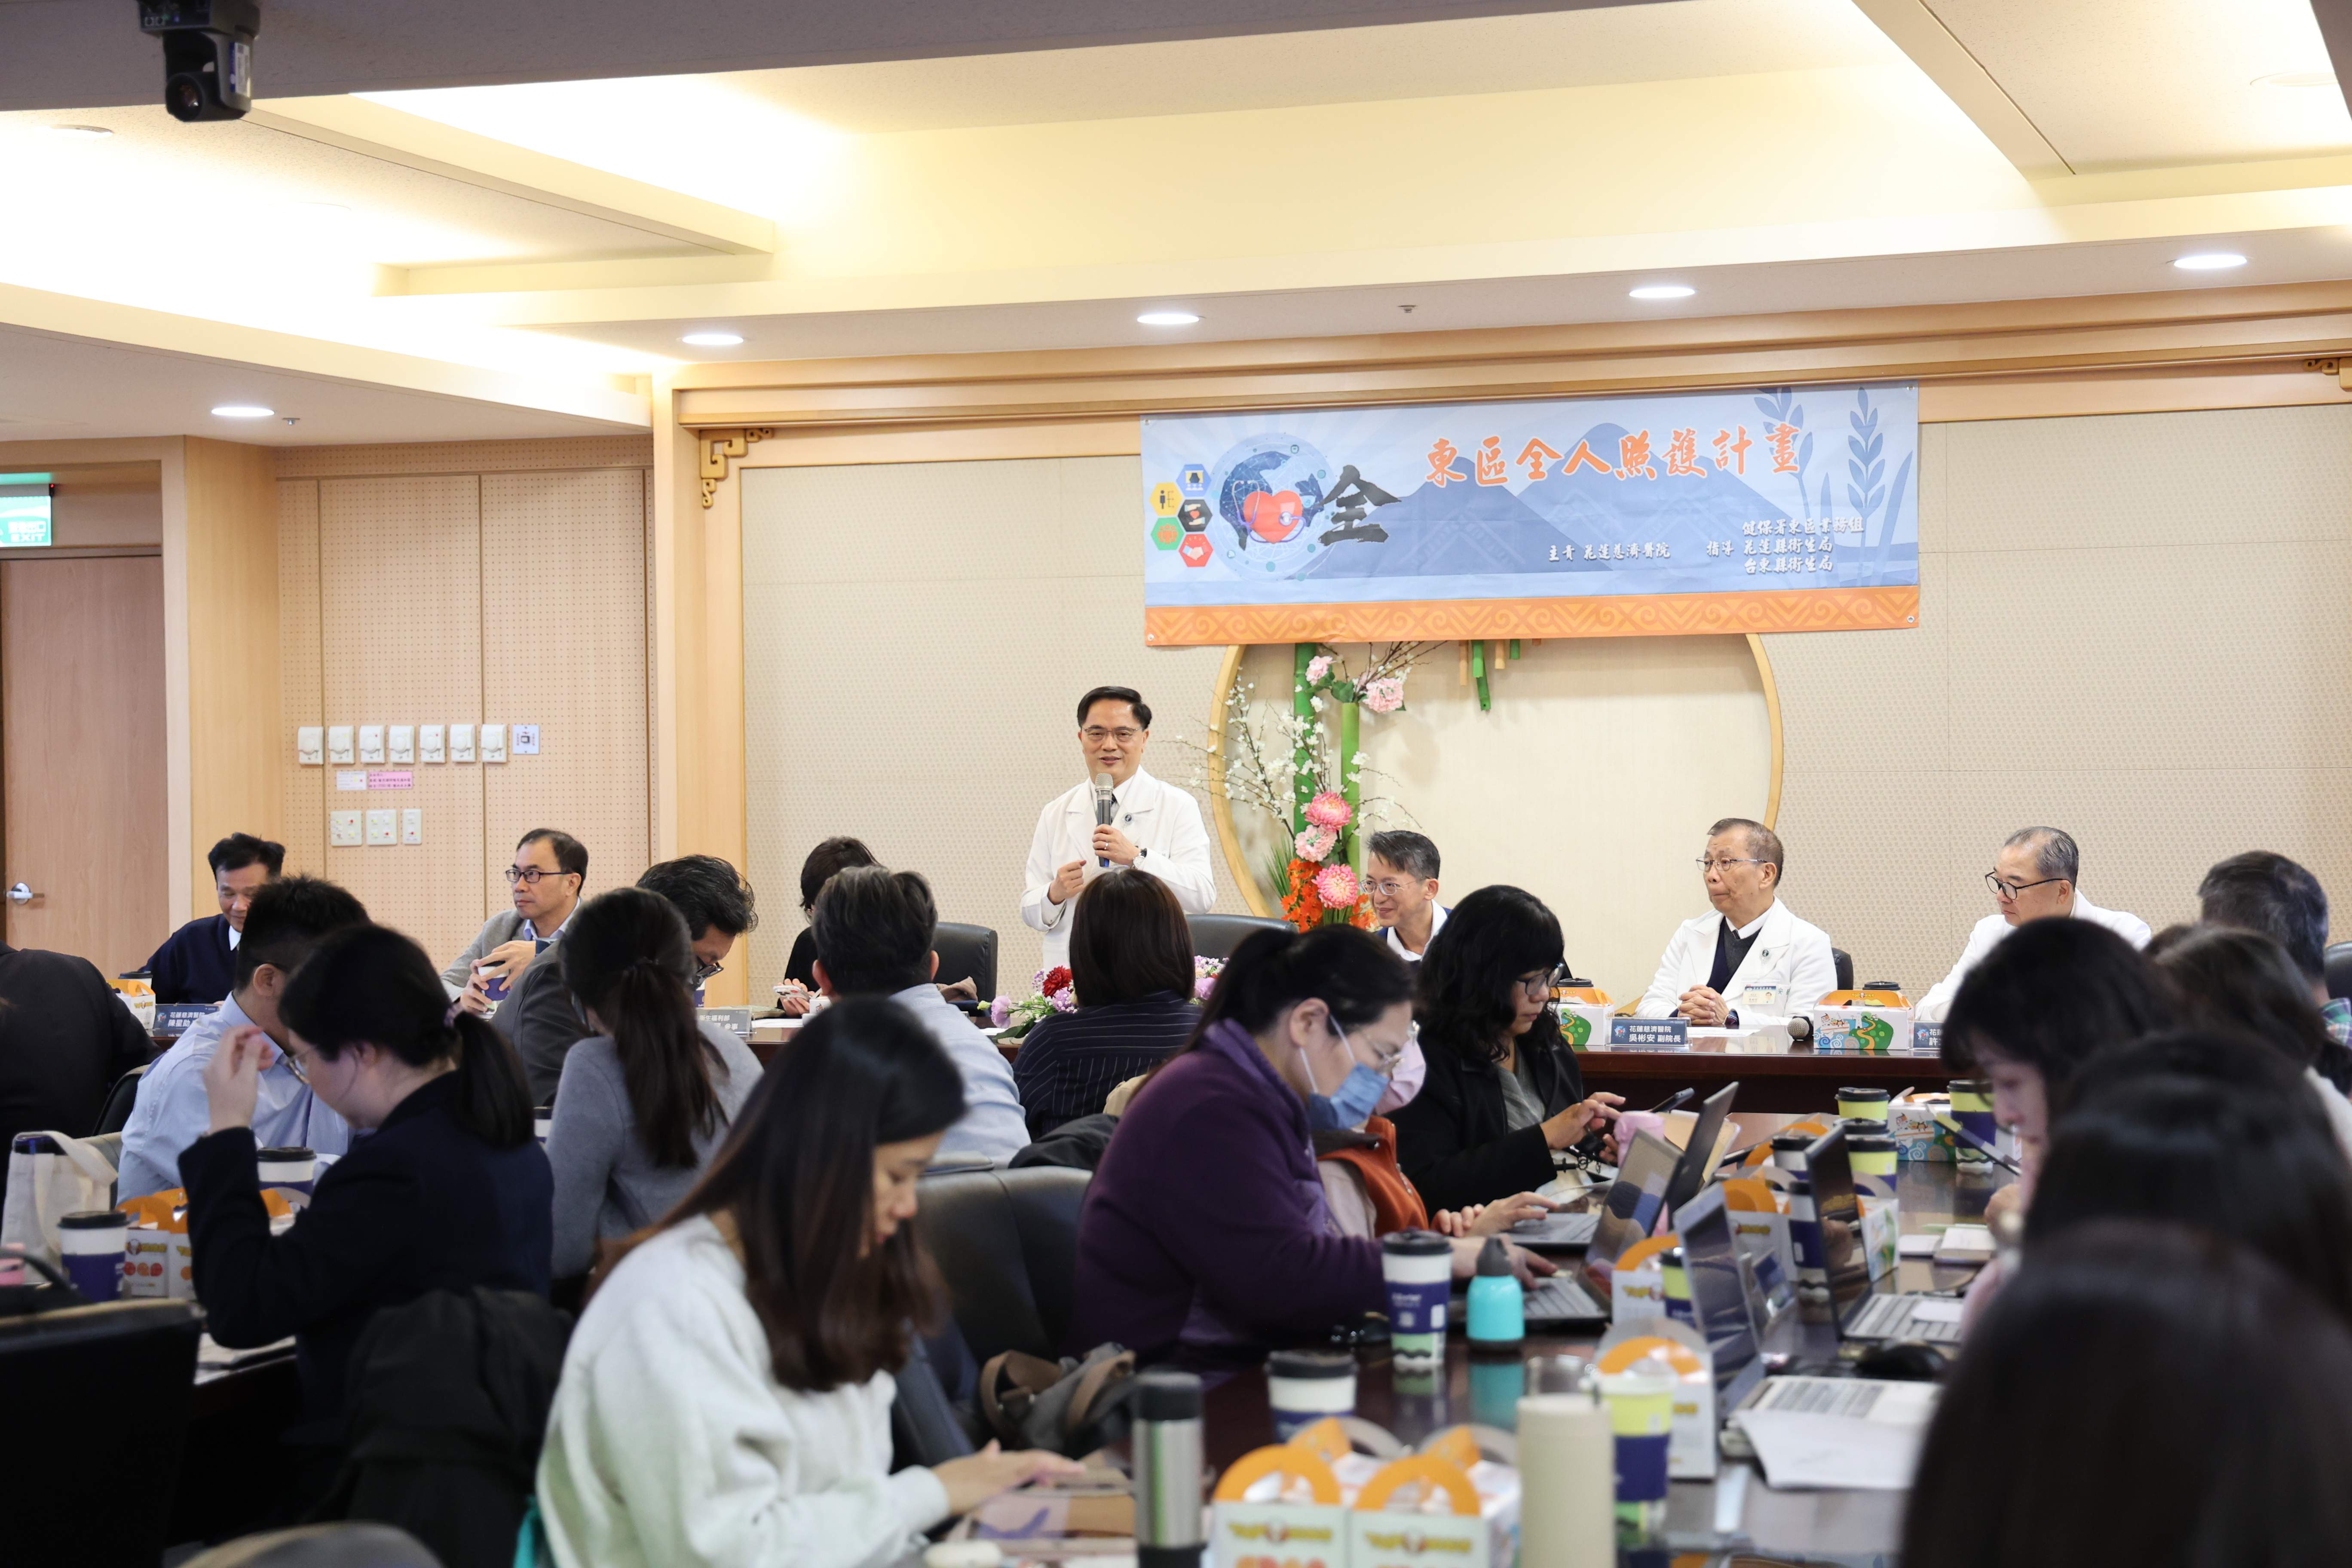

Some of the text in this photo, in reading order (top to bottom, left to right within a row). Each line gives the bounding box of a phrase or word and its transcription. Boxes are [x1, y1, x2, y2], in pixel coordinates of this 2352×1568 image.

[1426, 423, 1800, 487] 東區全人照護計畫
[1314, 465, 1402, 546] 全
[1743, 517, 1864, 536] 健保署東區業務組
[11, 533, 46, 542] EXIT
[1583, 542, 1671, 560] 花蓮慈濟醫院
[1744, 536, 1833, 555] 花蓮縣衛生局
[1744, 555, 1833, 574] 台東縣衛生局
[1629, 1034, 1681, 1043] 吳彬安 副院長
